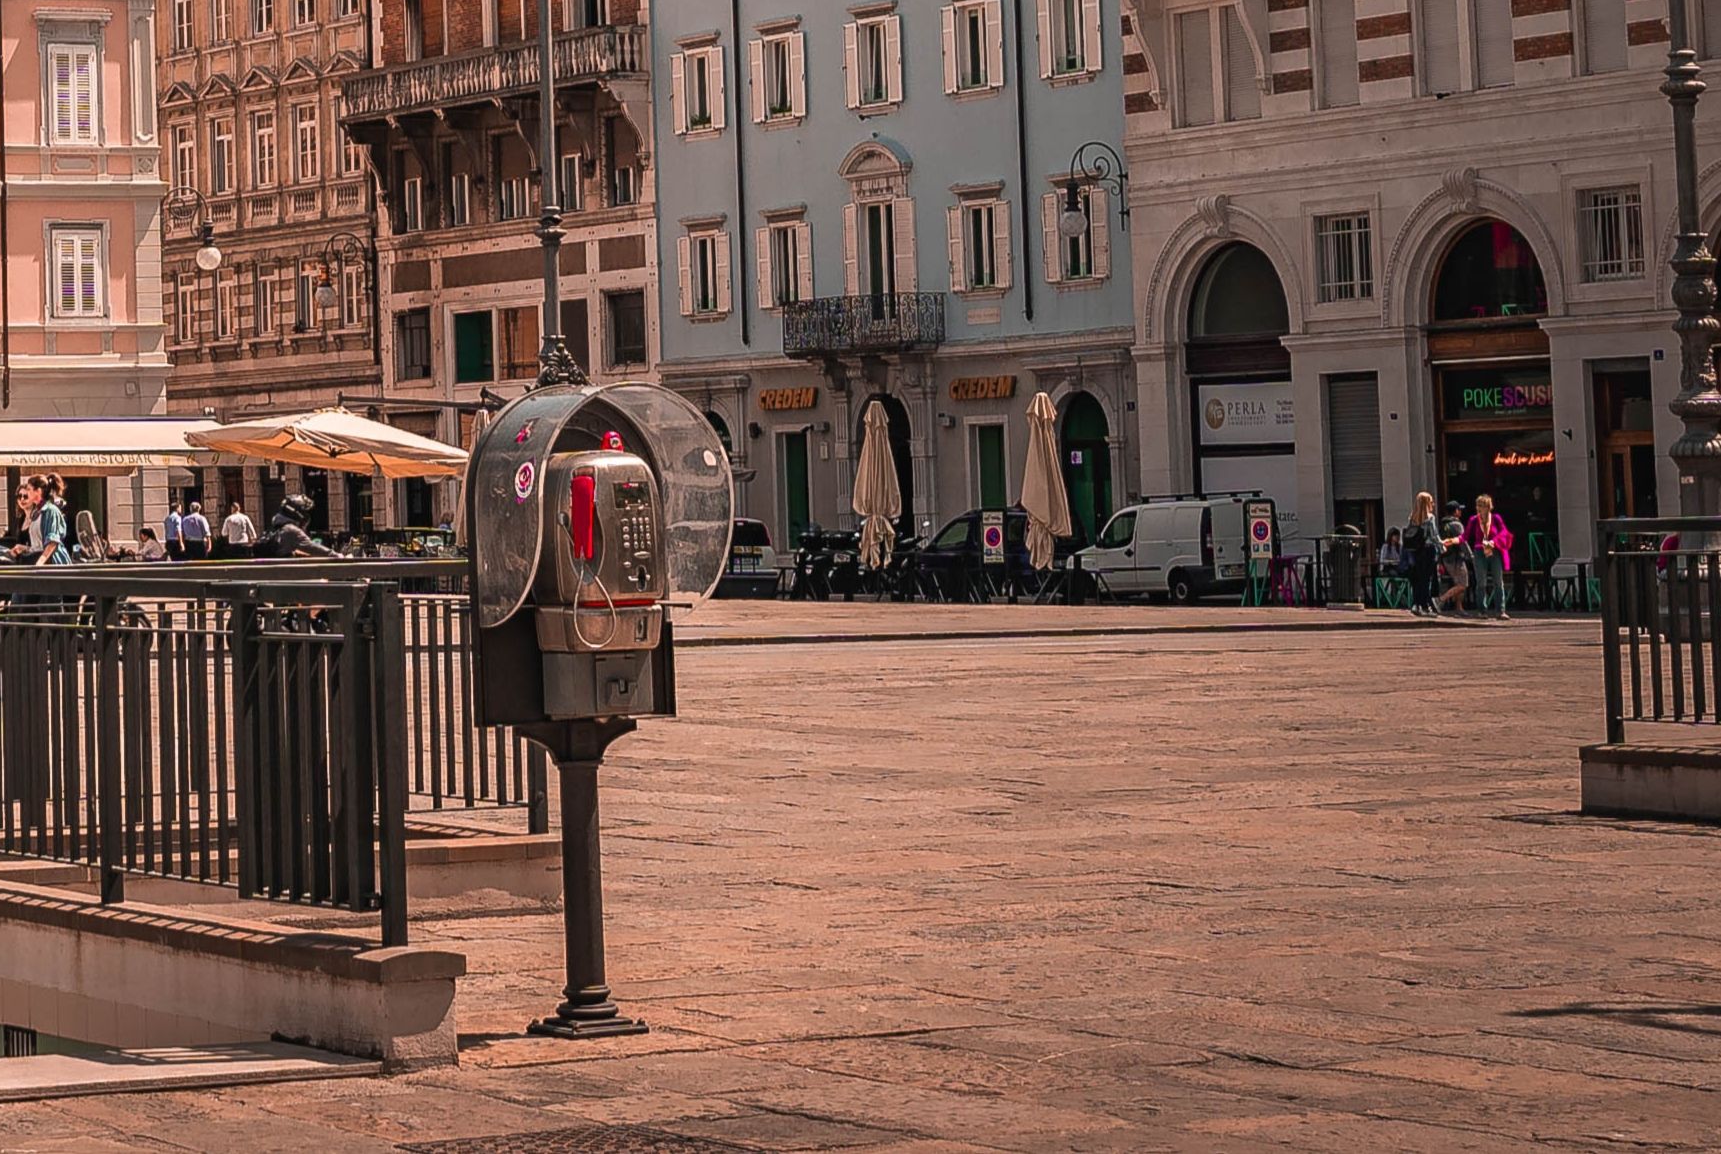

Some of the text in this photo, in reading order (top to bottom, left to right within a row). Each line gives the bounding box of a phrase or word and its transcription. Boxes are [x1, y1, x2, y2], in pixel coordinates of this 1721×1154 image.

[950, 376, 1013, 401] CREDEM
[759, 387, 816, 410] CREDEM
[1227, 401, 1266, 415] PERLA
[89, 453, 124, 464] RISTO
[128, 453, 152, 464] BAR
